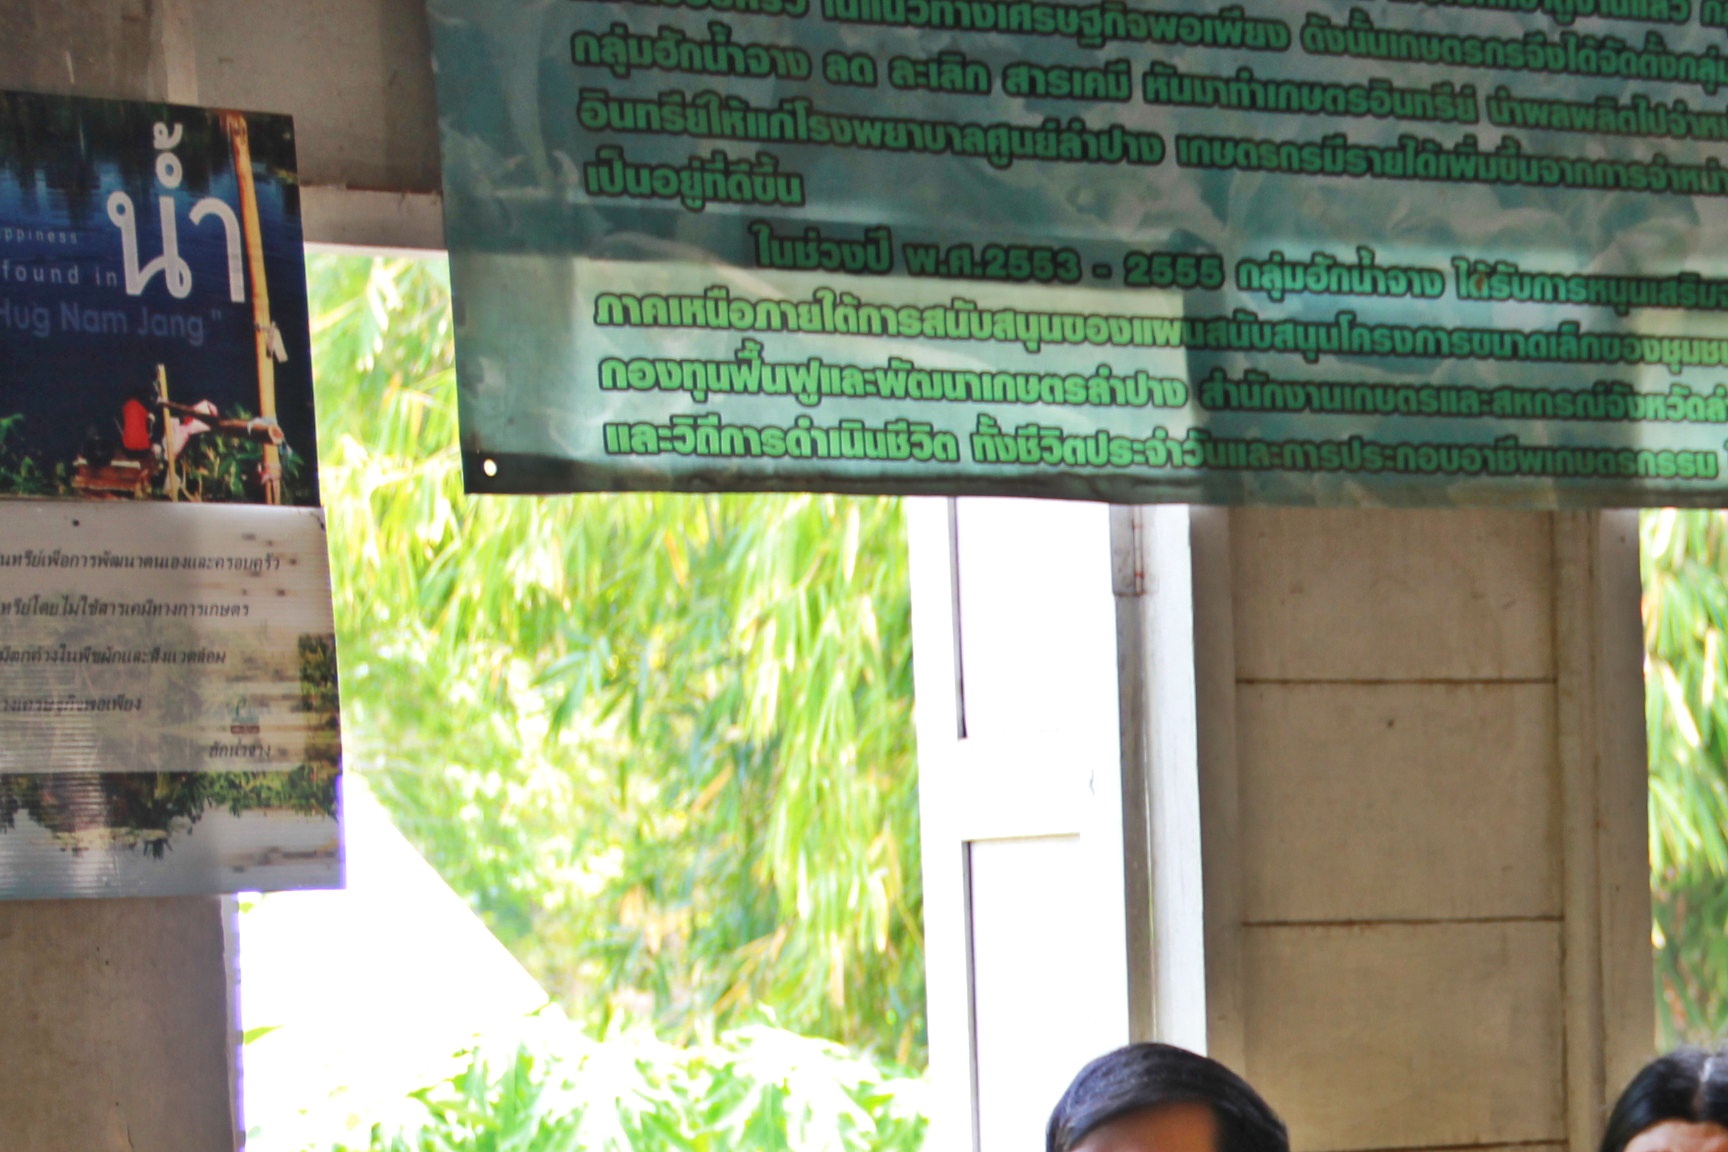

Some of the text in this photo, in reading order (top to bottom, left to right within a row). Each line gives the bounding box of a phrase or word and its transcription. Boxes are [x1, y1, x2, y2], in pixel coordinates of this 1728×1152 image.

[823, 51, 877, 88] ลด
[106, 120, 246, 303] น้ำ
[1123, 250, 1225, 289] 2555
[60, 301, 128, 335] Nam
